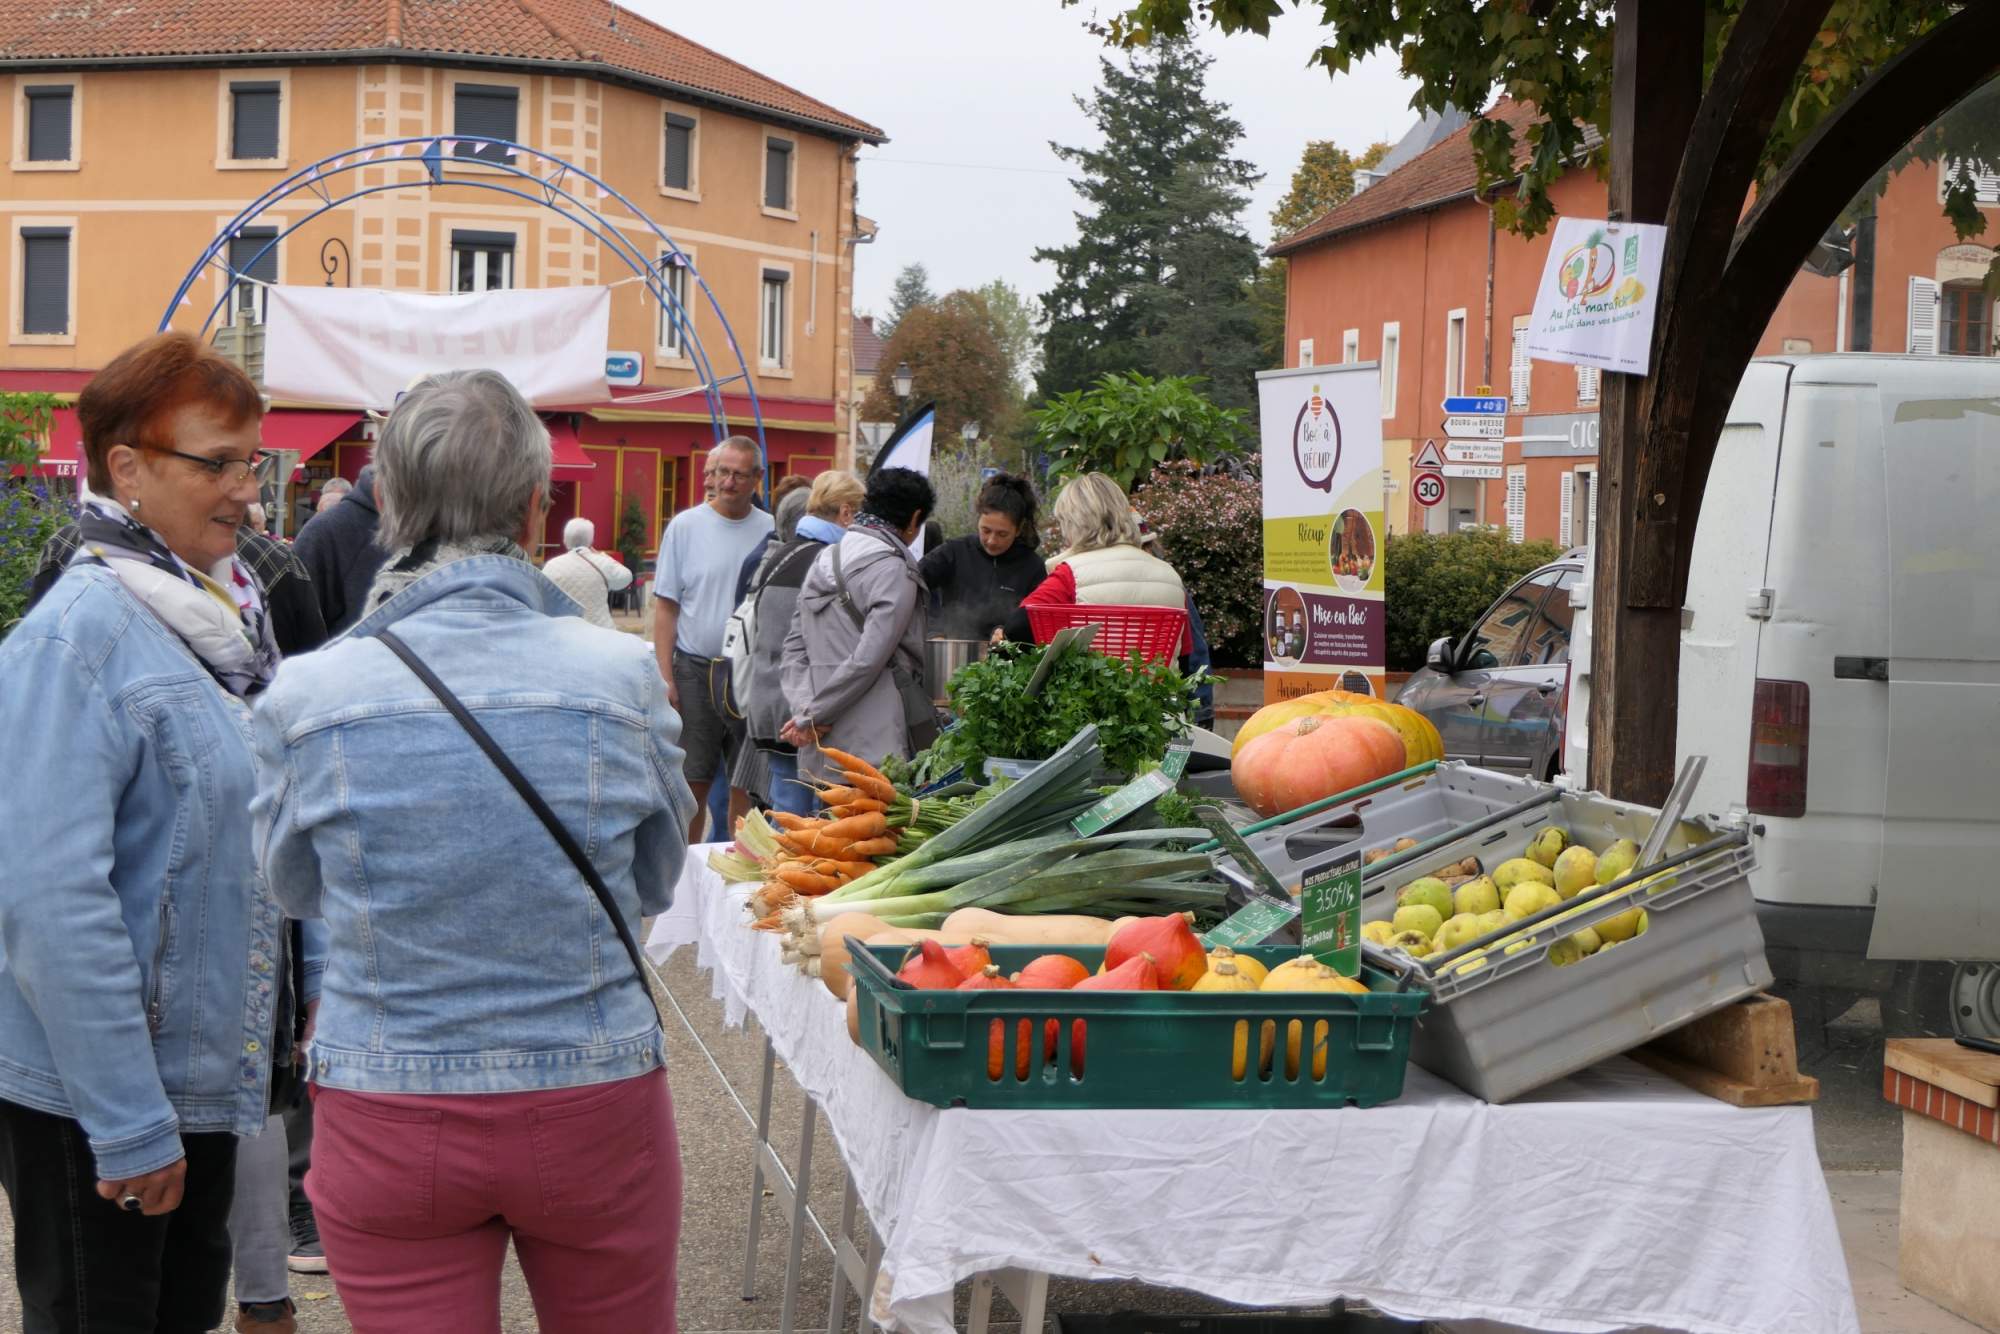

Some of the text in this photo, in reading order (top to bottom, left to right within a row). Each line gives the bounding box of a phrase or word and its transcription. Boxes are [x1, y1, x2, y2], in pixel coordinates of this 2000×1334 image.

[1475, 401, 1494, 410] A 40
[1570, 420, 1597, 449] CIC
[57, 464, 70, 476] LE
[1420, 482, 1440, 497] 30
[1313, 603, 1332, 626] Mise
[1334, 610, 1347, 625] en
